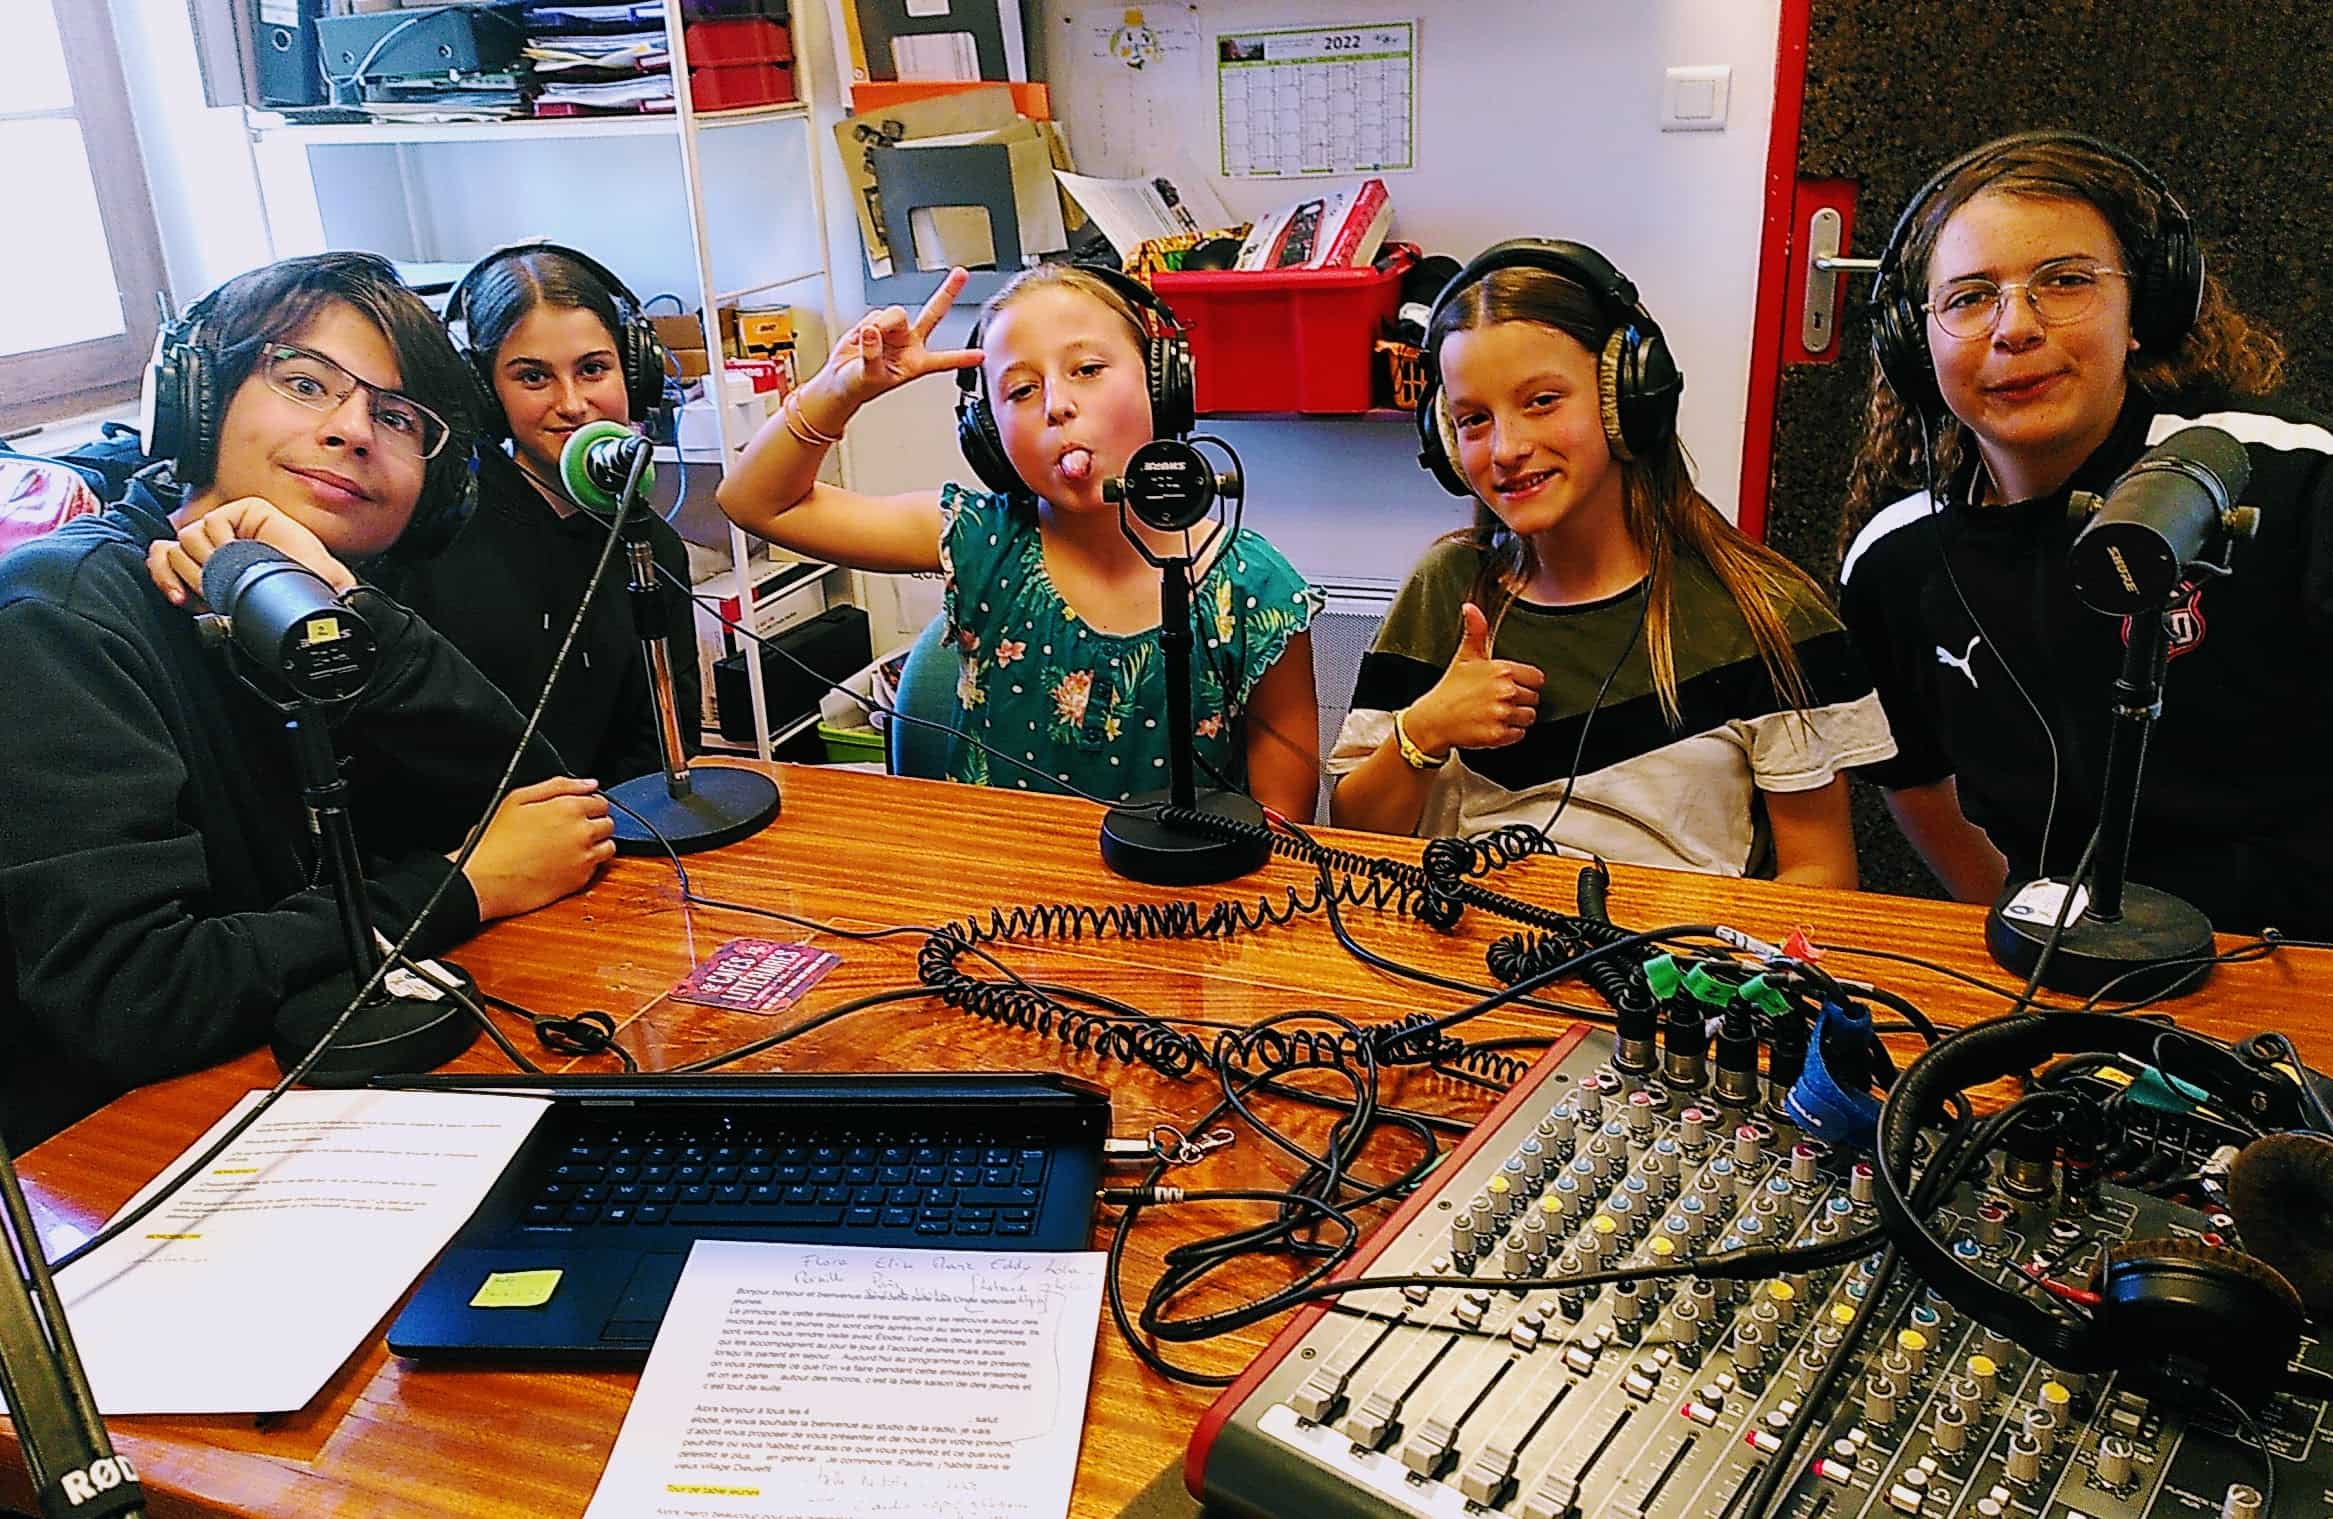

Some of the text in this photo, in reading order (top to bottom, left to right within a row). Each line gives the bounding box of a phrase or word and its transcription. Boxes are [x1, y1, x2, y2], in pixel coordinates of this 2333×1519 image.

[1324, 35, 1361, 50] 2022
[2106, 545, 2138, 594] SHURE
[706, 955, 757, 985] CAFÉS
[719, 949, 801, 1002] LITTÉRAIRES
